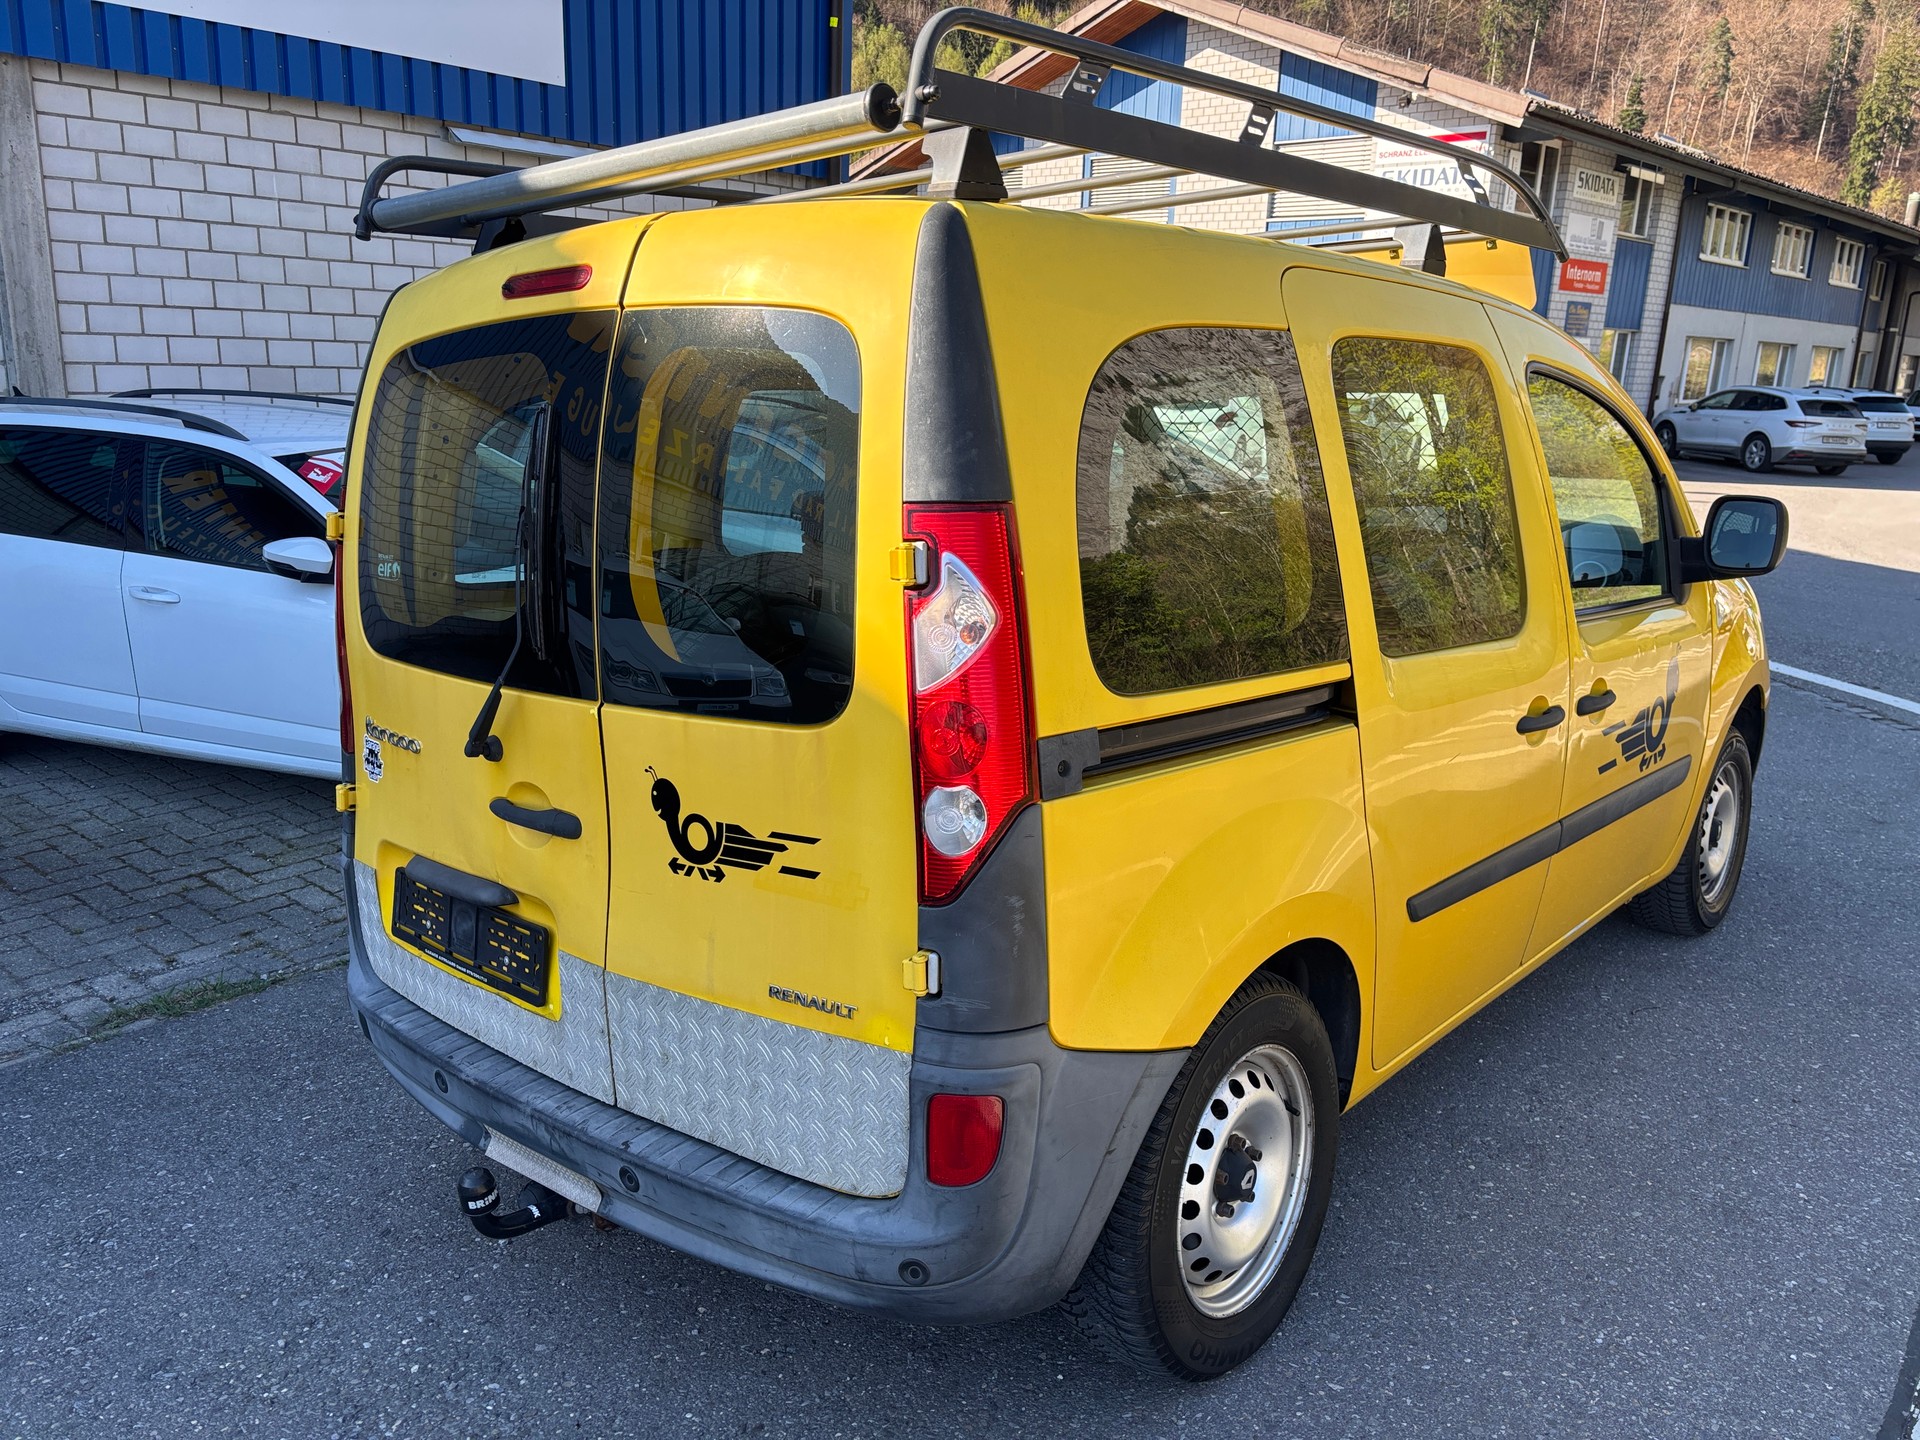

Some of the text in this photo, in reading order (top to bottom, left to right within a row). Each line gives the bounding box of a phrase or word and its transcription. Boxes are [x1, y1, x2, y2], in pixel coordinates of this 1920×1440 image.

[1379, 149, 1412, 159] SCHRANZ
[1577, 171, 1615, 196] SKIDATA
[1566, 263, 1602, 282] Internorm
[377, 562, 392, 577] elf
[769, 986, 858, 1020] RENAULT
